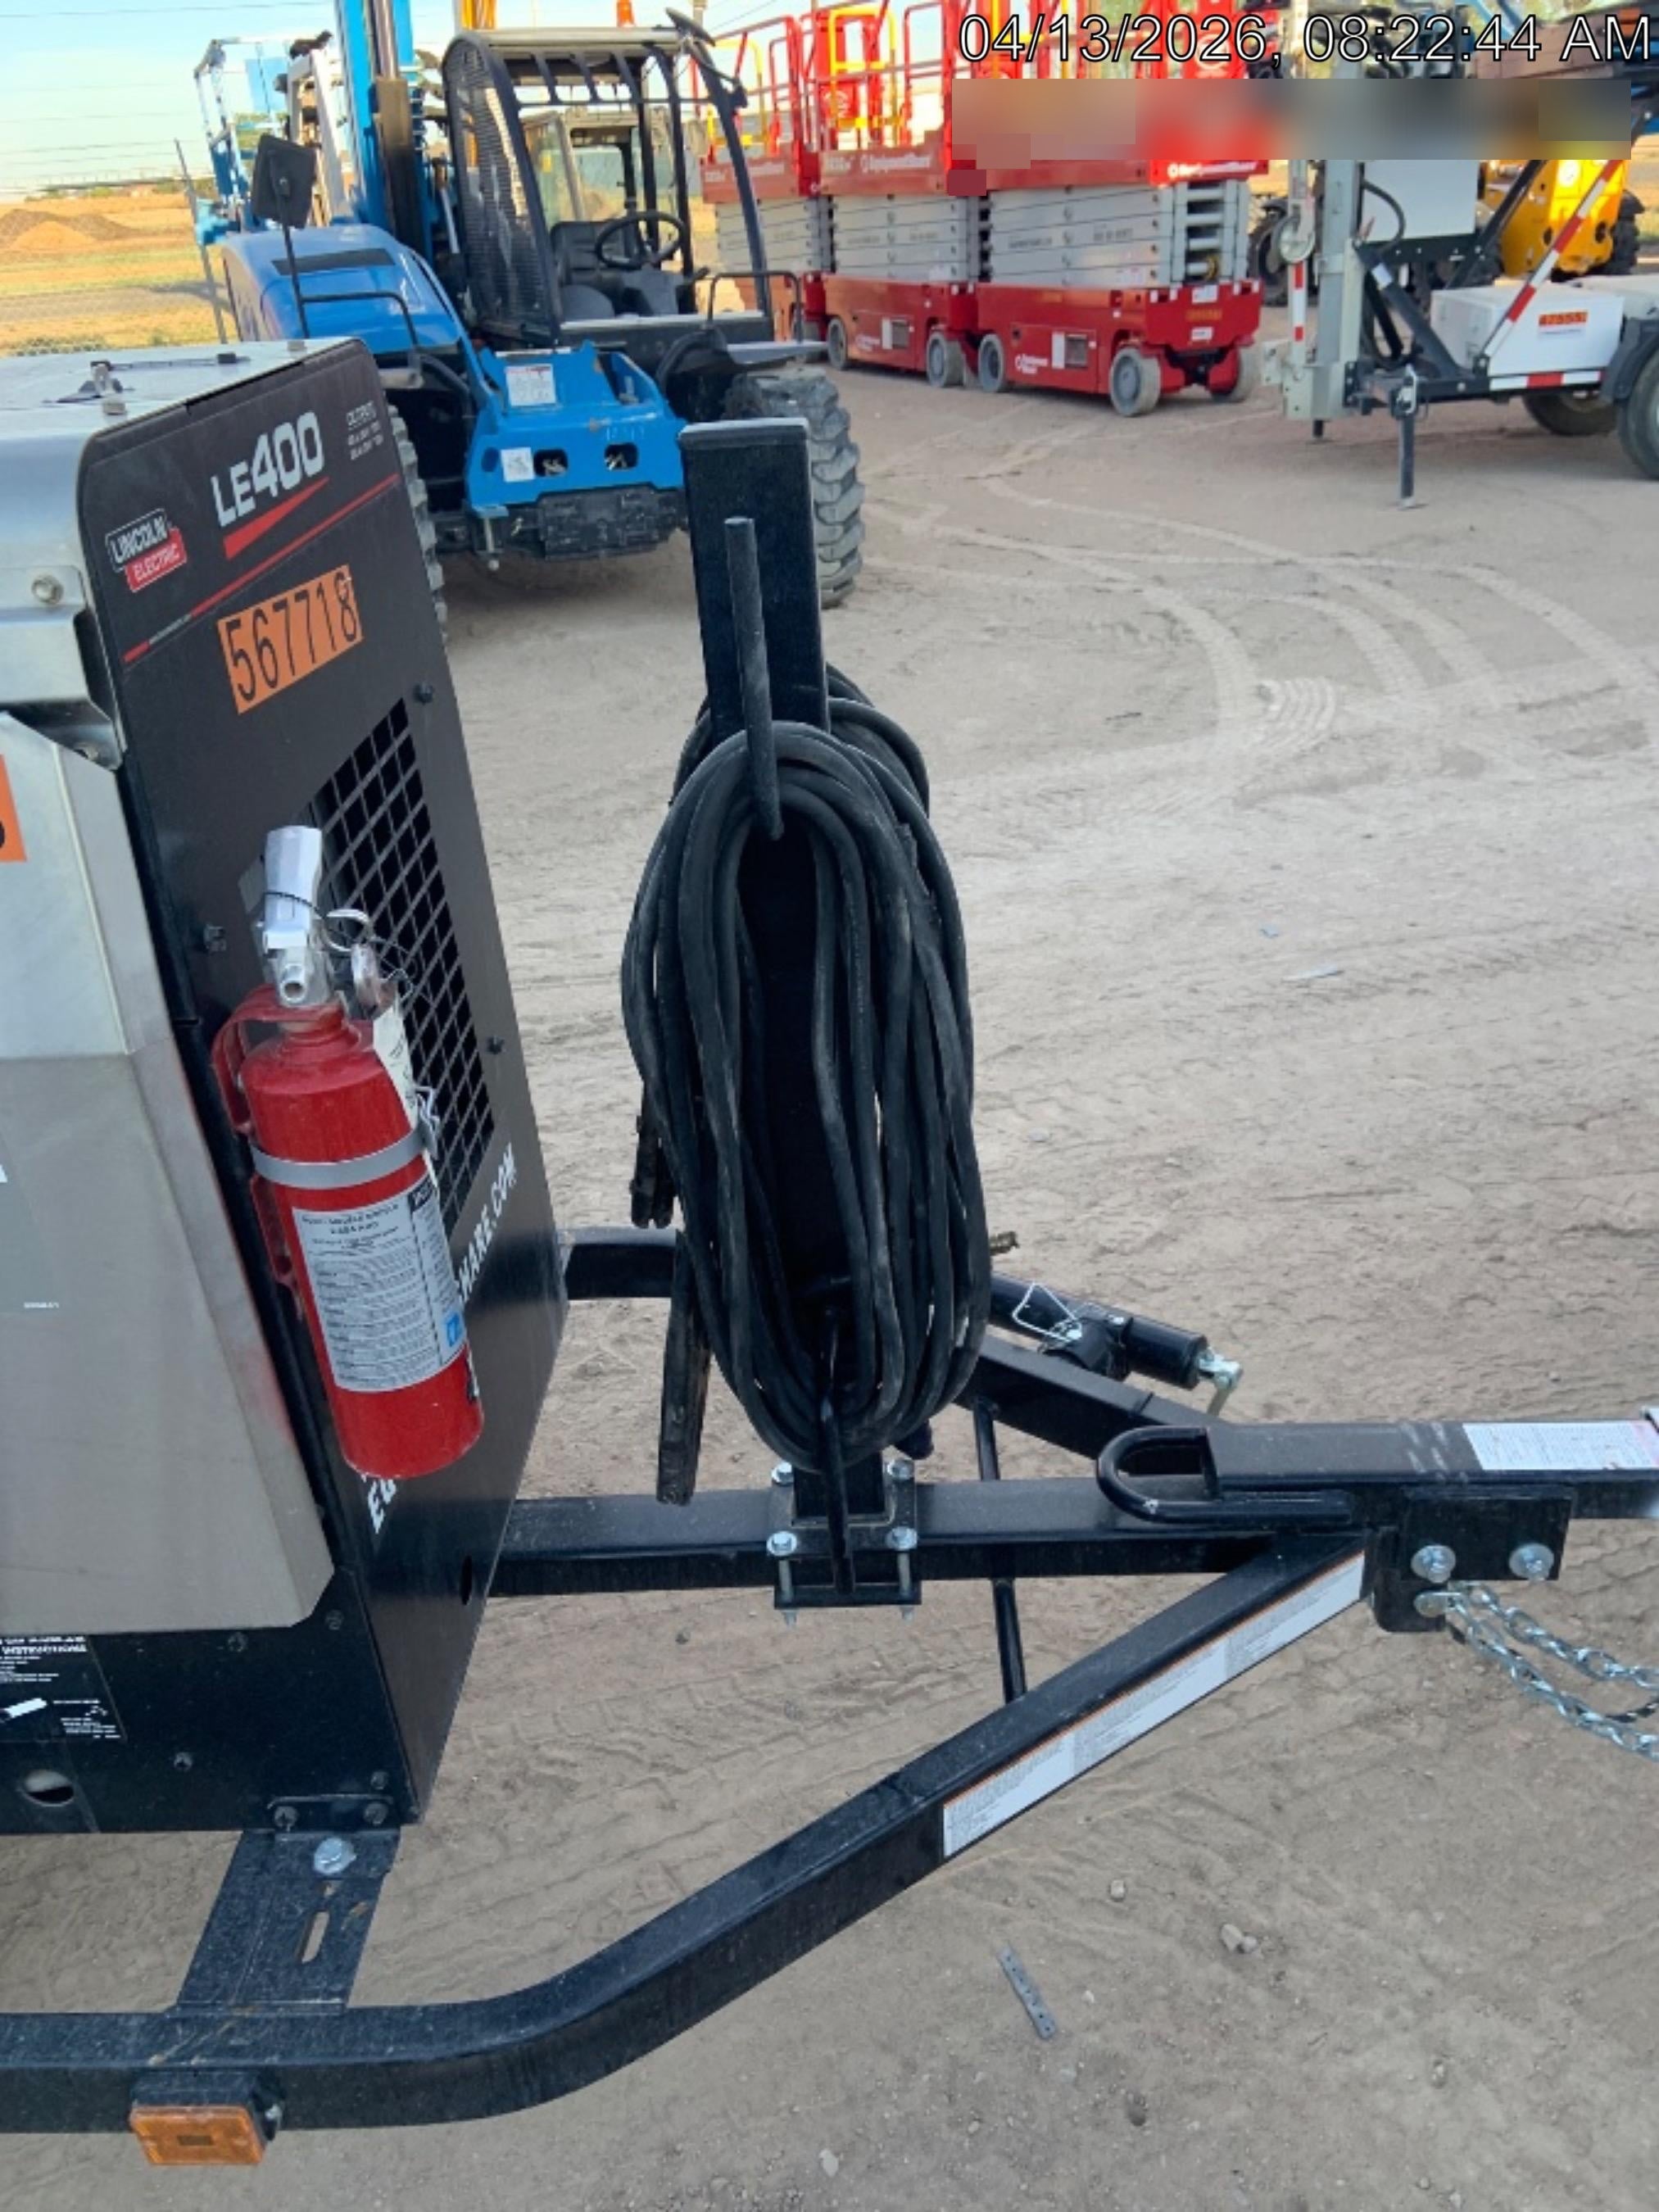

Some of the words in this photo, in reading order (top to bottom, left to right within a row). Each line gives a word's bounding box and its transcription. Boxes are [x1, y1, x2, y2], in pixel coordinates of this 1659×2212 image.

[210, 411, 325, 528] LE400
[110, 515, 167, 564] LINCOLN
[134, 542, 180, 582] ELECTRIC
[225, 571, 356, 701] 567718
